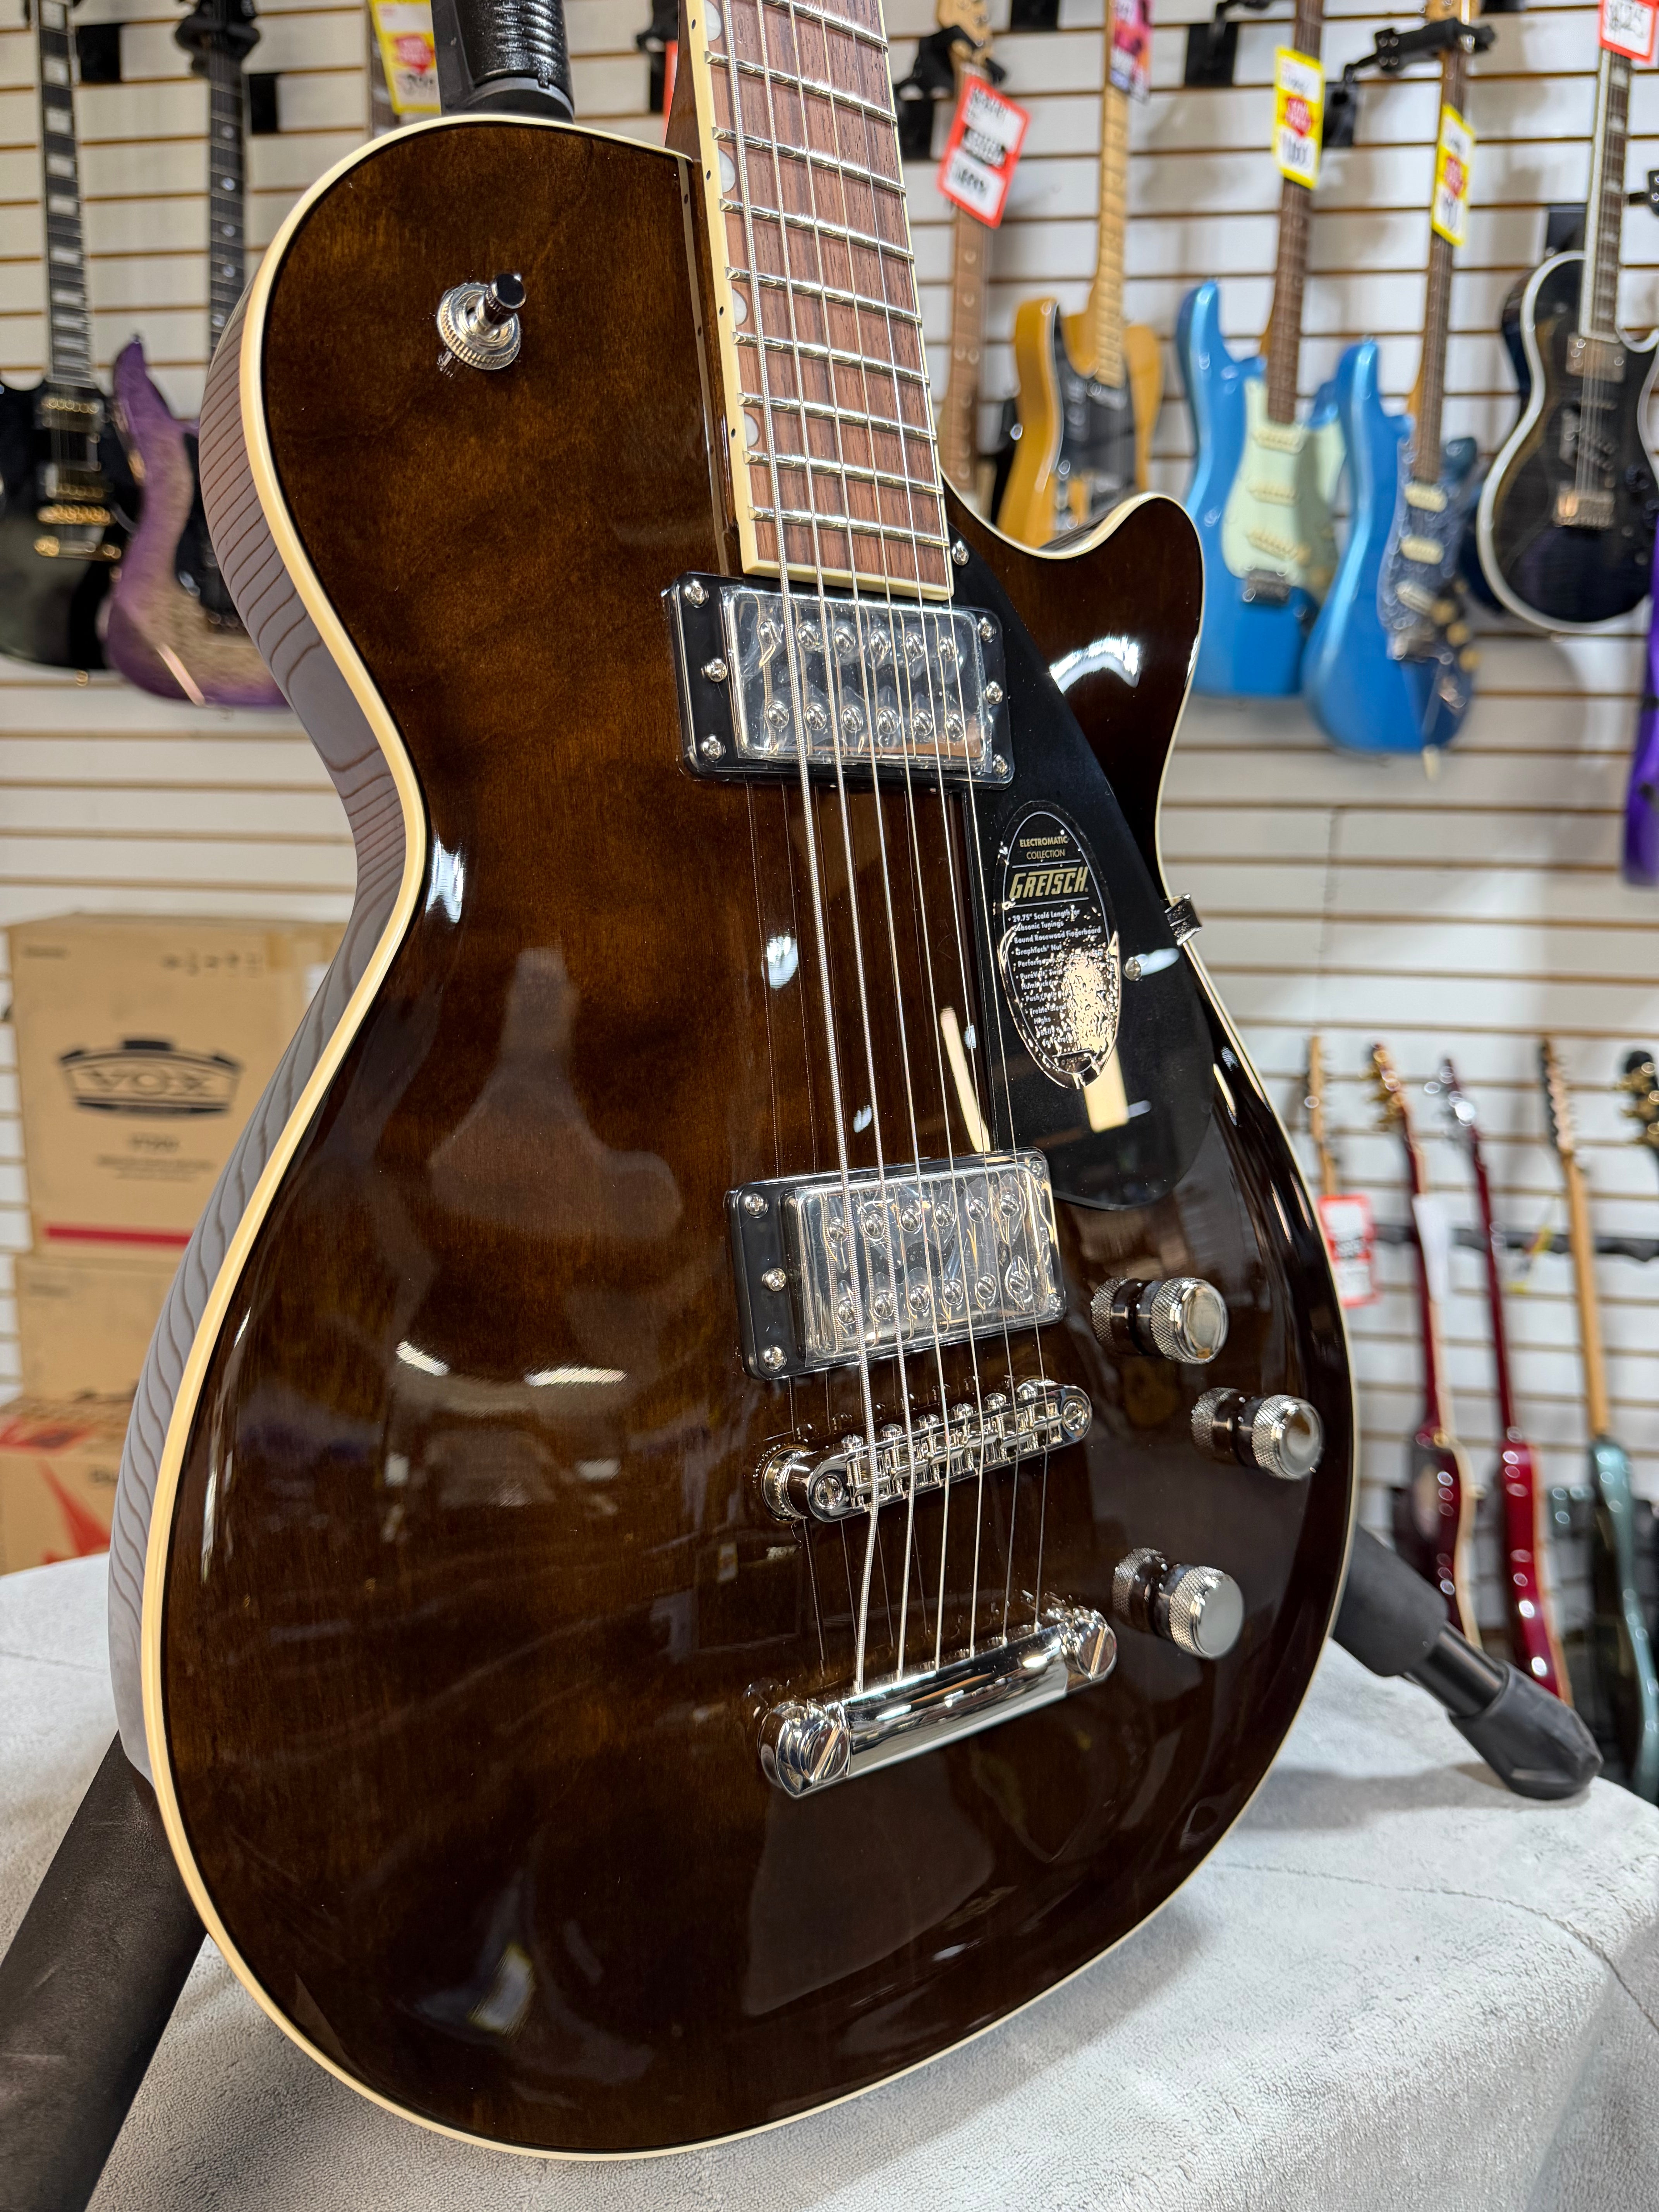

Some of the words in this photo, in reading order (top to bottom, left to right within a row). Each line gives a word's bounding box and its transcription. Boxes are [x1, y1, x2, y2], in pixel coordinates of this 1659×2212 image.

[1019, 835, 1068, 847] ELECTROMATIC
[1026, 849, 1065, 860] COLLECTION
[1009, 866, 1089, 899] GRETSCH
[1034, 912, 1049, 920] Scale
[1050, 908, 1070, 919] Length
[1013, 922, 1040, 932] Subsonic
[1041, 921, 1064, 929] Tunings
[1014, 934, 1034, 944] Bound
[1034, 931, 1065, 941] Rosewood
[1066, 926, 1102, 938] Fingerboard
[1017, 957, 1056, 967] Perform
[1025, 992, 1055, 1002] Push/Pll
[1033, 1016, 1052, 1025] Hghs
